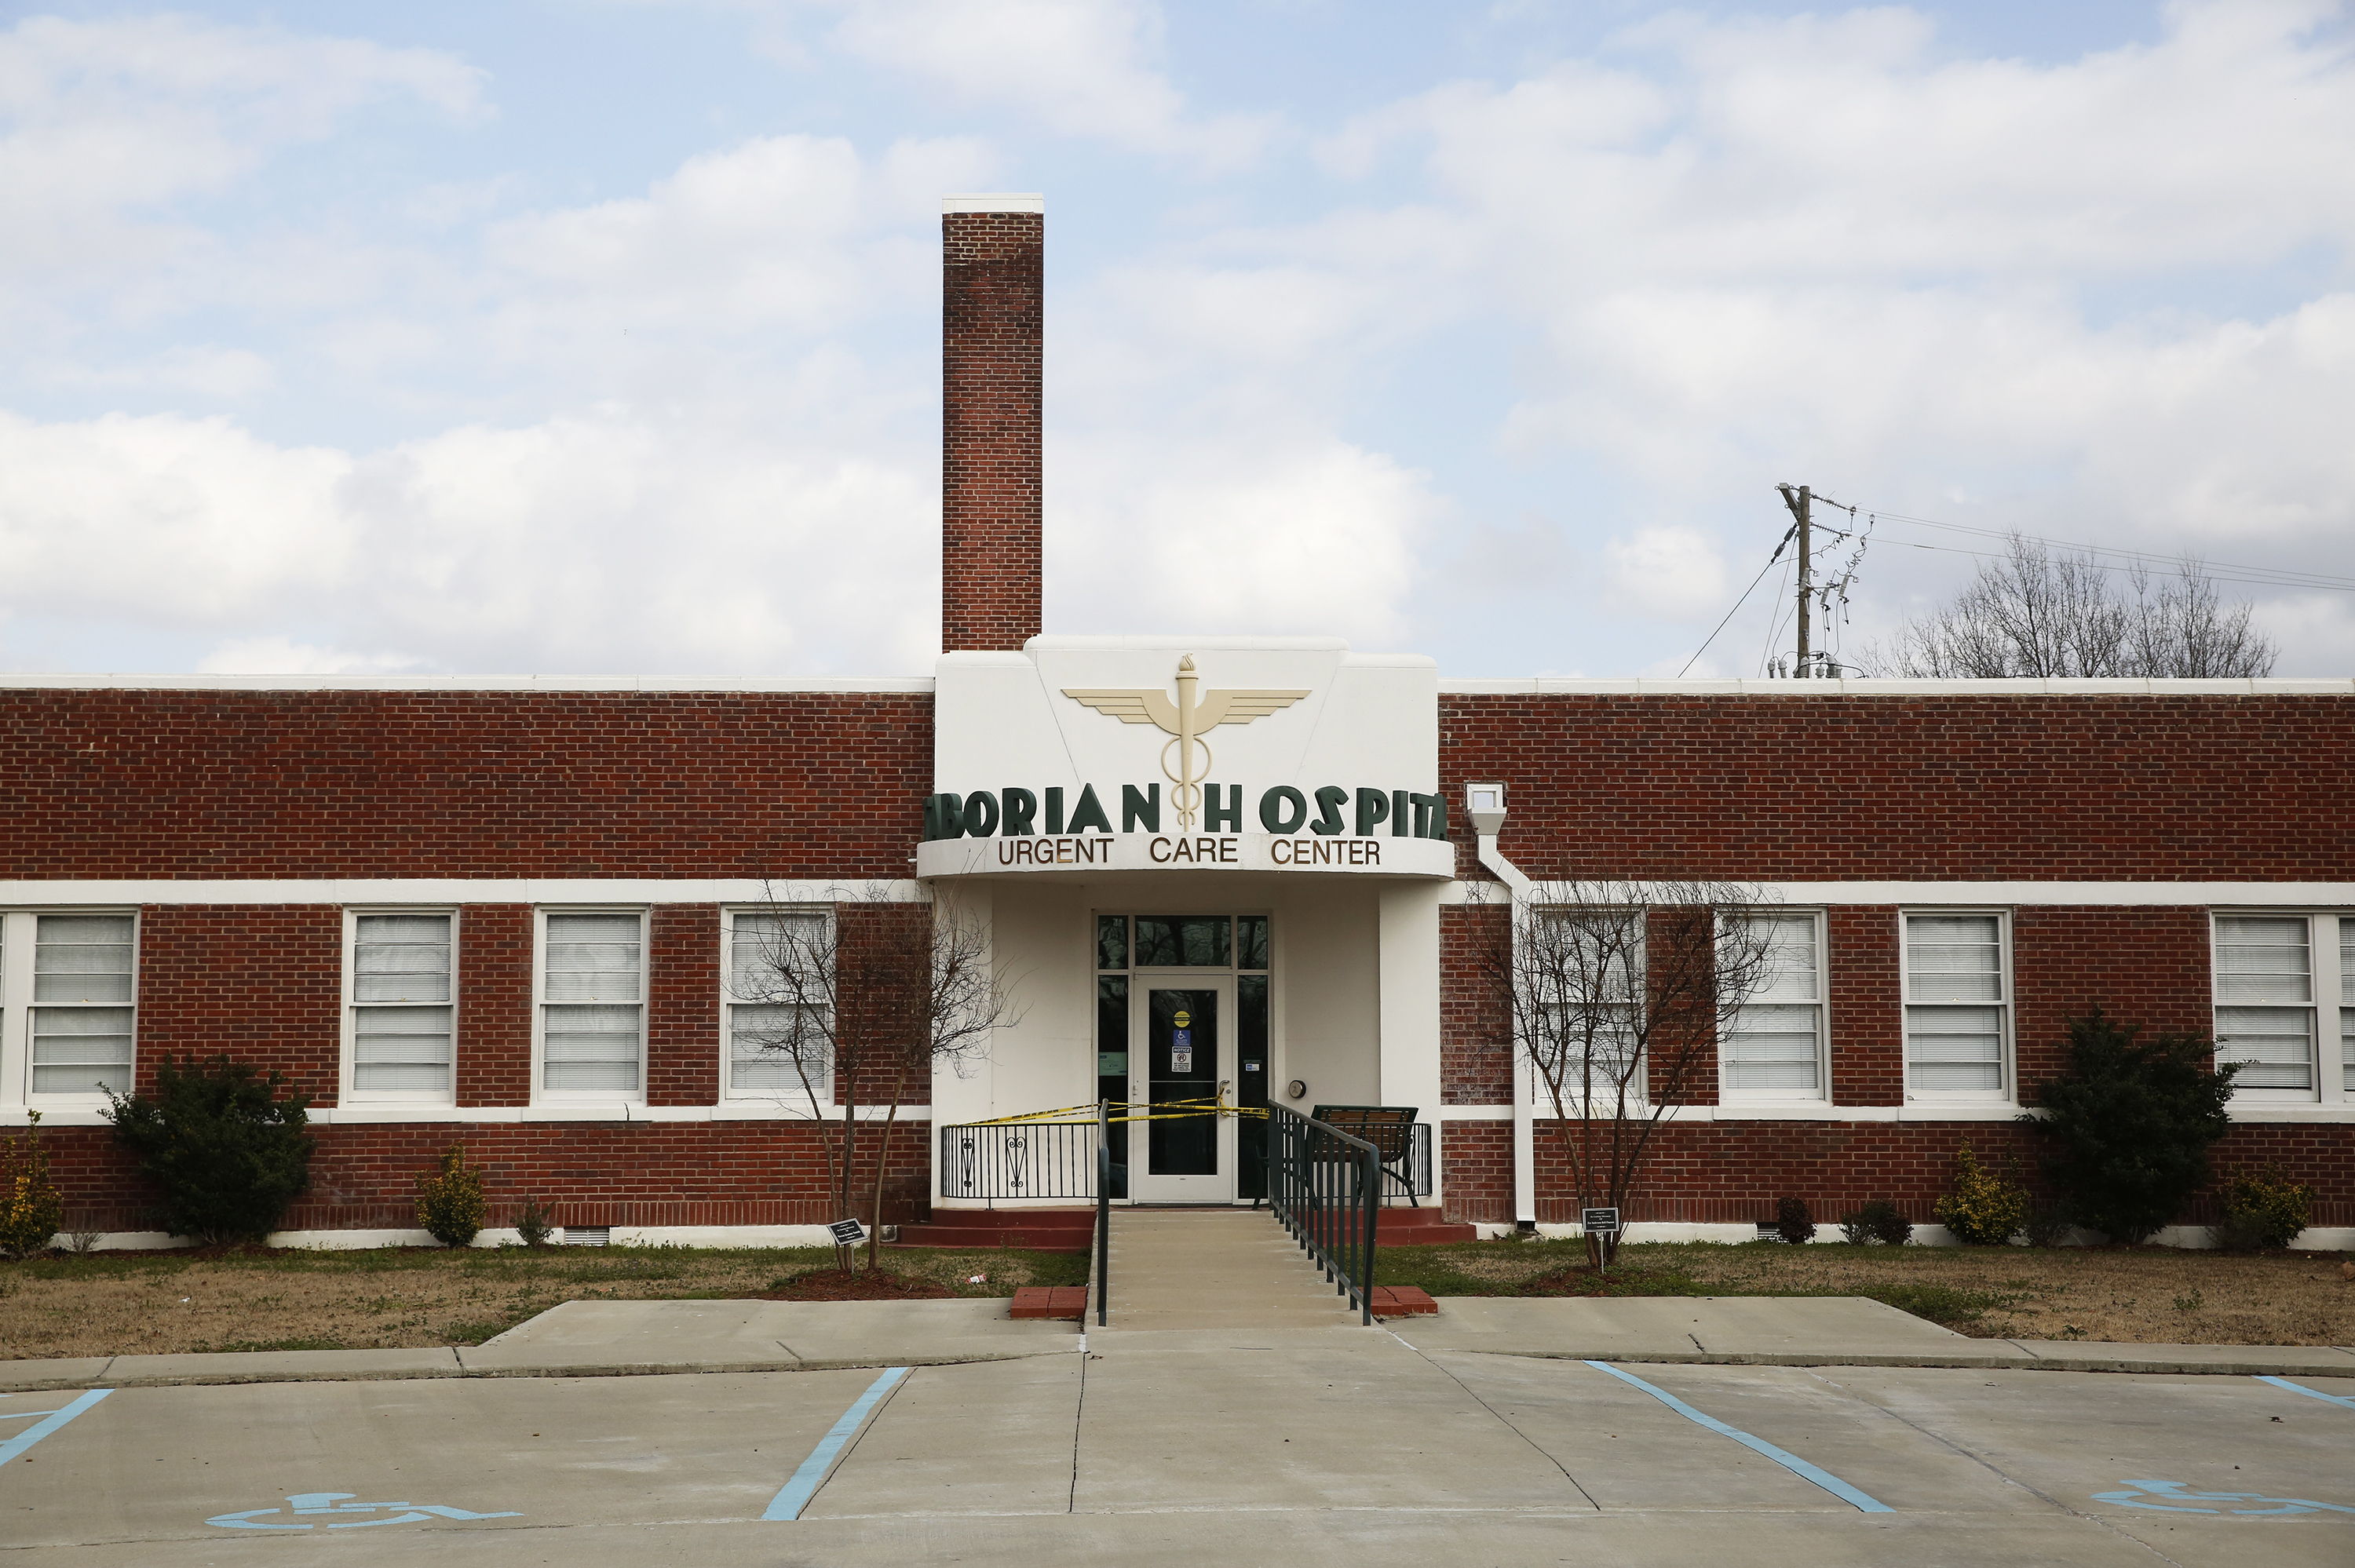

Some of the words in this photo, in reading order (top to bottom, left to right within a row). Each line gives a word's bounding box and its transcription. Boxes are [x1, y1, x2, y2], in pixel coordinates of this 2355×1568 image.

[999, 837, 1114, 865] URGENT
[1149, 837, 1238, 862] CARE
[1271, 839, 1381, 865] CENTER
